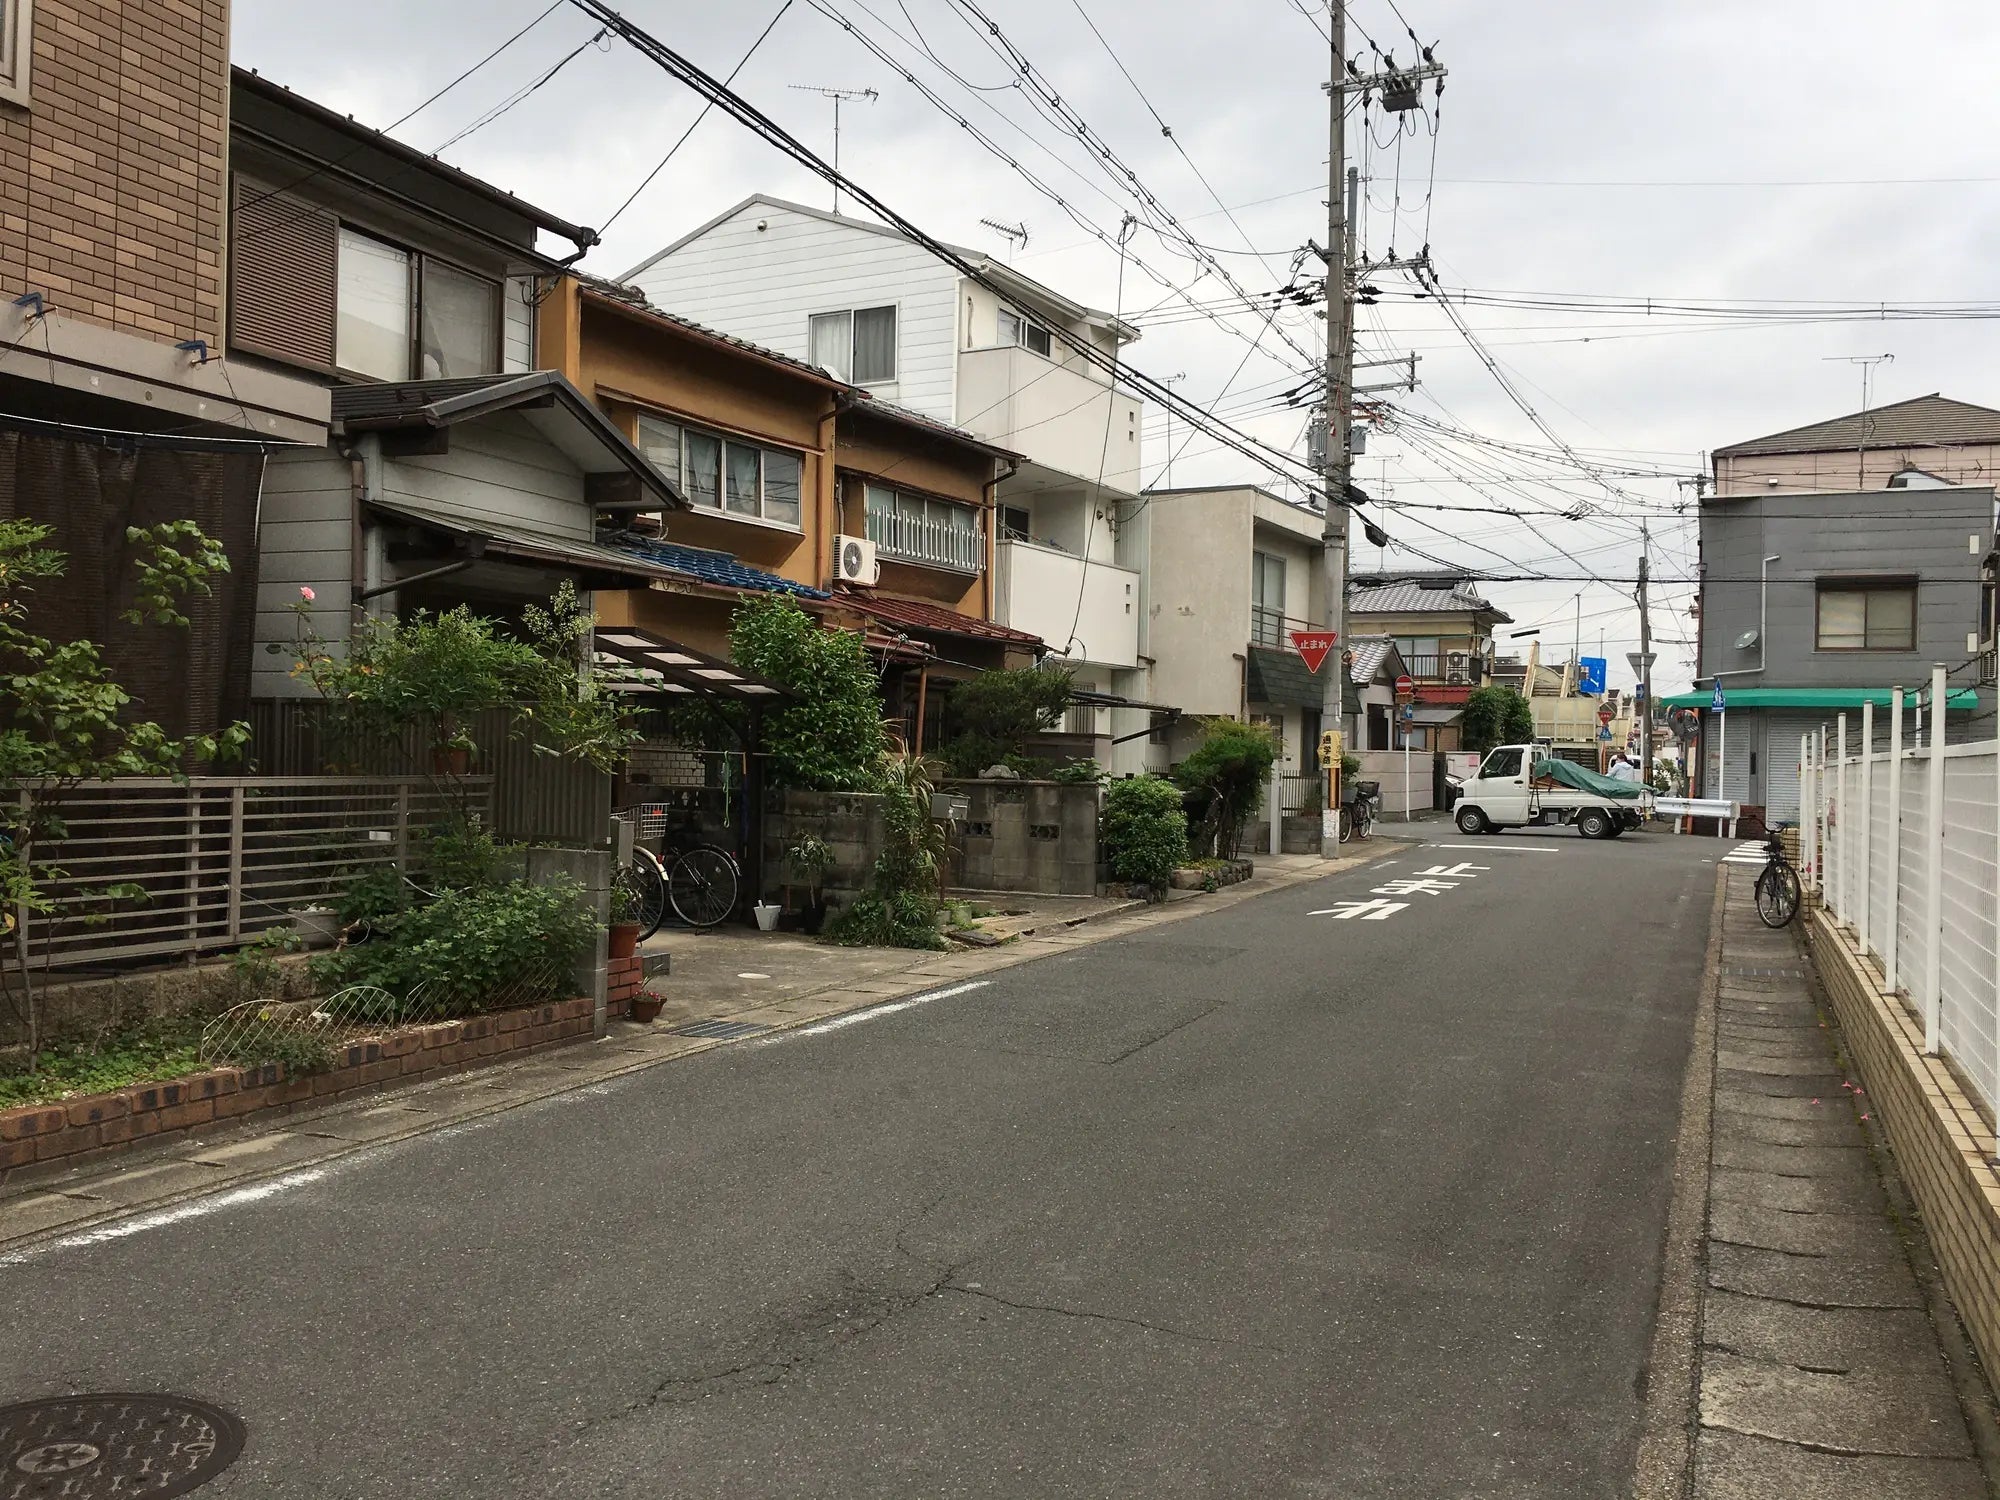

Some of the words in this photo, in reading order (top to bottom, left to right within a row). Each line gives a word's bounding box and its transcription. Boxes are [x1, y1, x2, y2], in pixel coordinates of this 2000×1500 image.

[1300, 639, 1328, 649] 止まれ
[1322, 735, 1331, 764] 通学路
[1306, 863, 1491, 919] 止まれ
